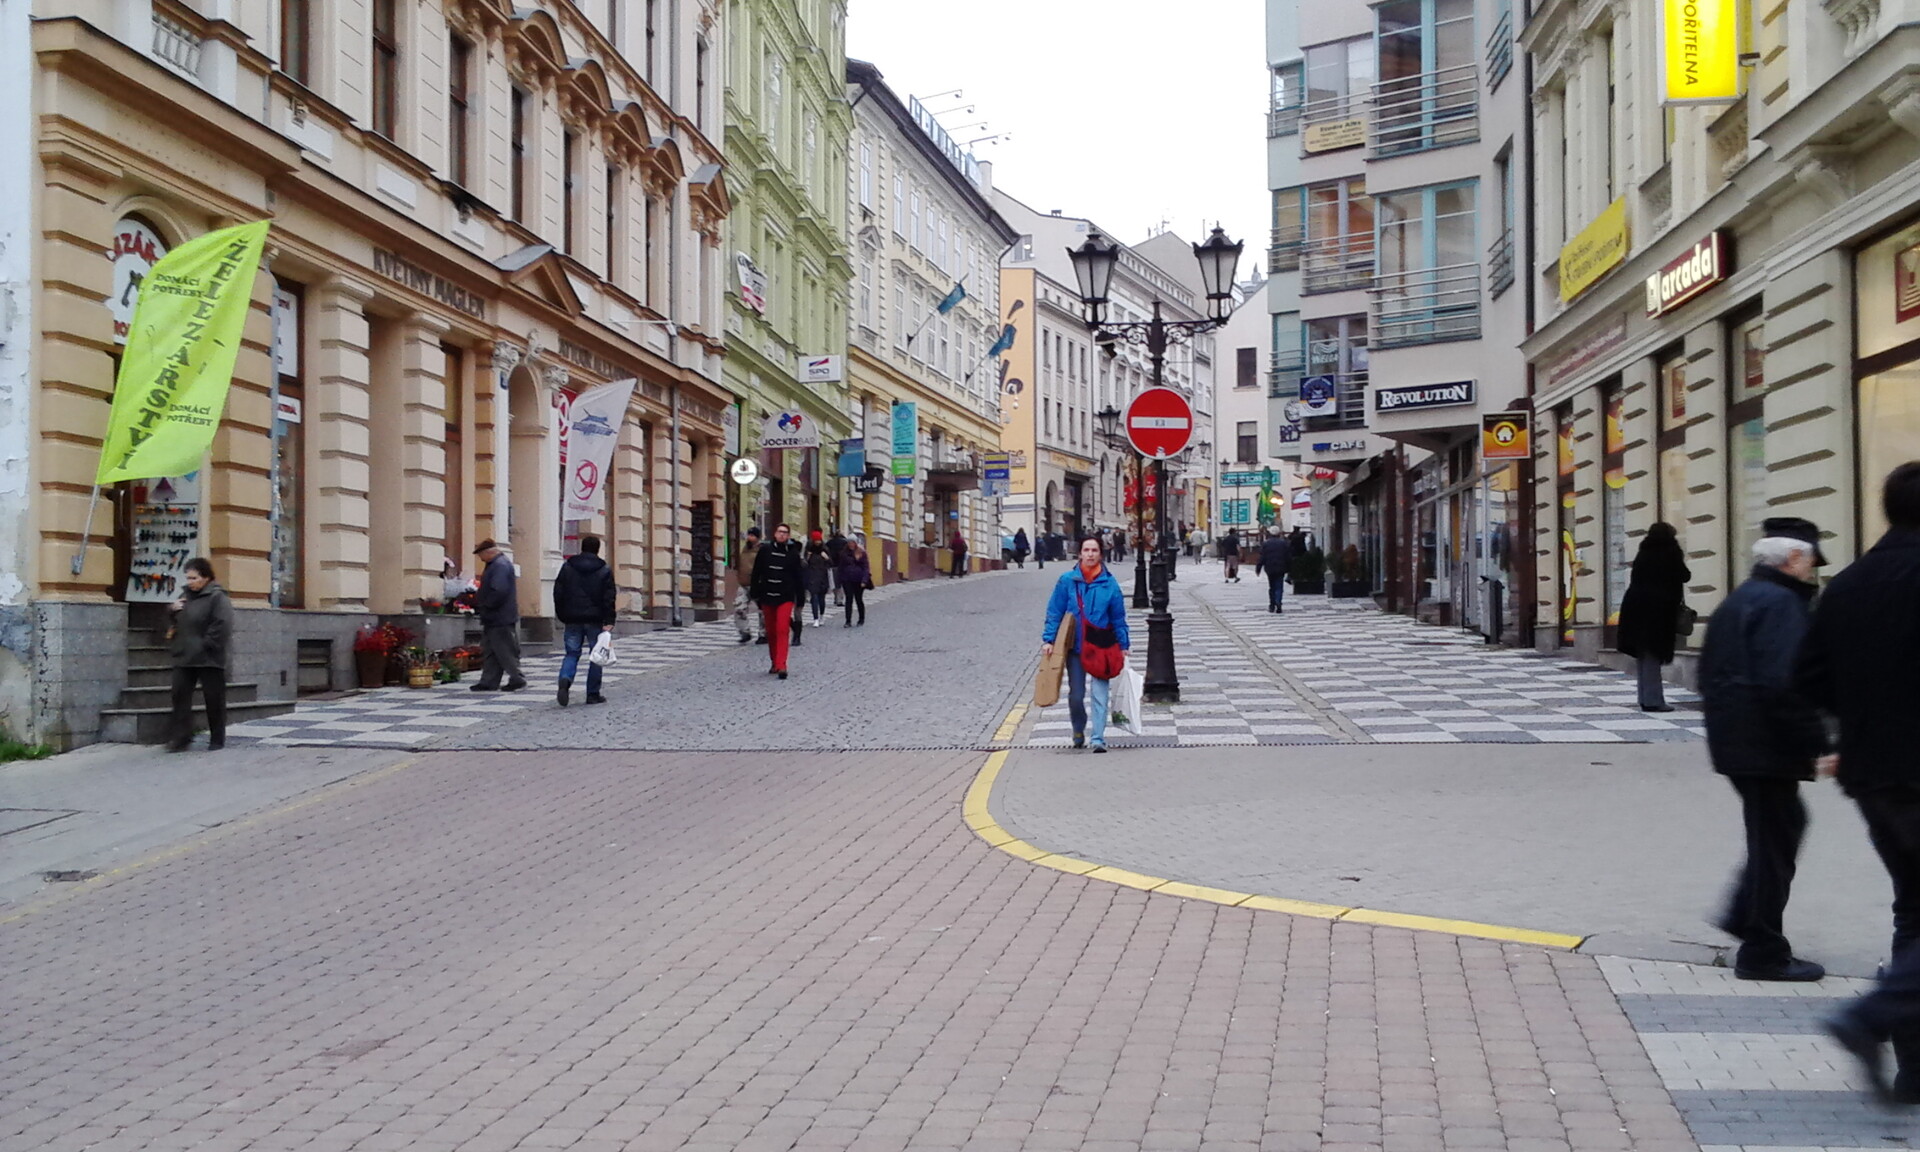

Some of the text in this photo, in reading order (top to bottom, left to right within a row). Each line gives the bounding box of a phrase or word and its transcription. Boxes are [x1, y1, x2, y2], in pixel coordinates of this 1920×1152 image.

[156, 273, 200, 286] DOMÁCÍ
[1661, 243, 1712, 302] arcada
[152, 284, 204, 298] POTŘEBY
[118, 239, 249, 469] ŽELEZÁŘSTVÍ
[1380, 384, 1467, 407] REVOLUTION
[169, 403, 211, 416] DOMÁCÍ
[166, 413, 213, 427] POTŘEBY
[856, 476, 878, 489] Lord
